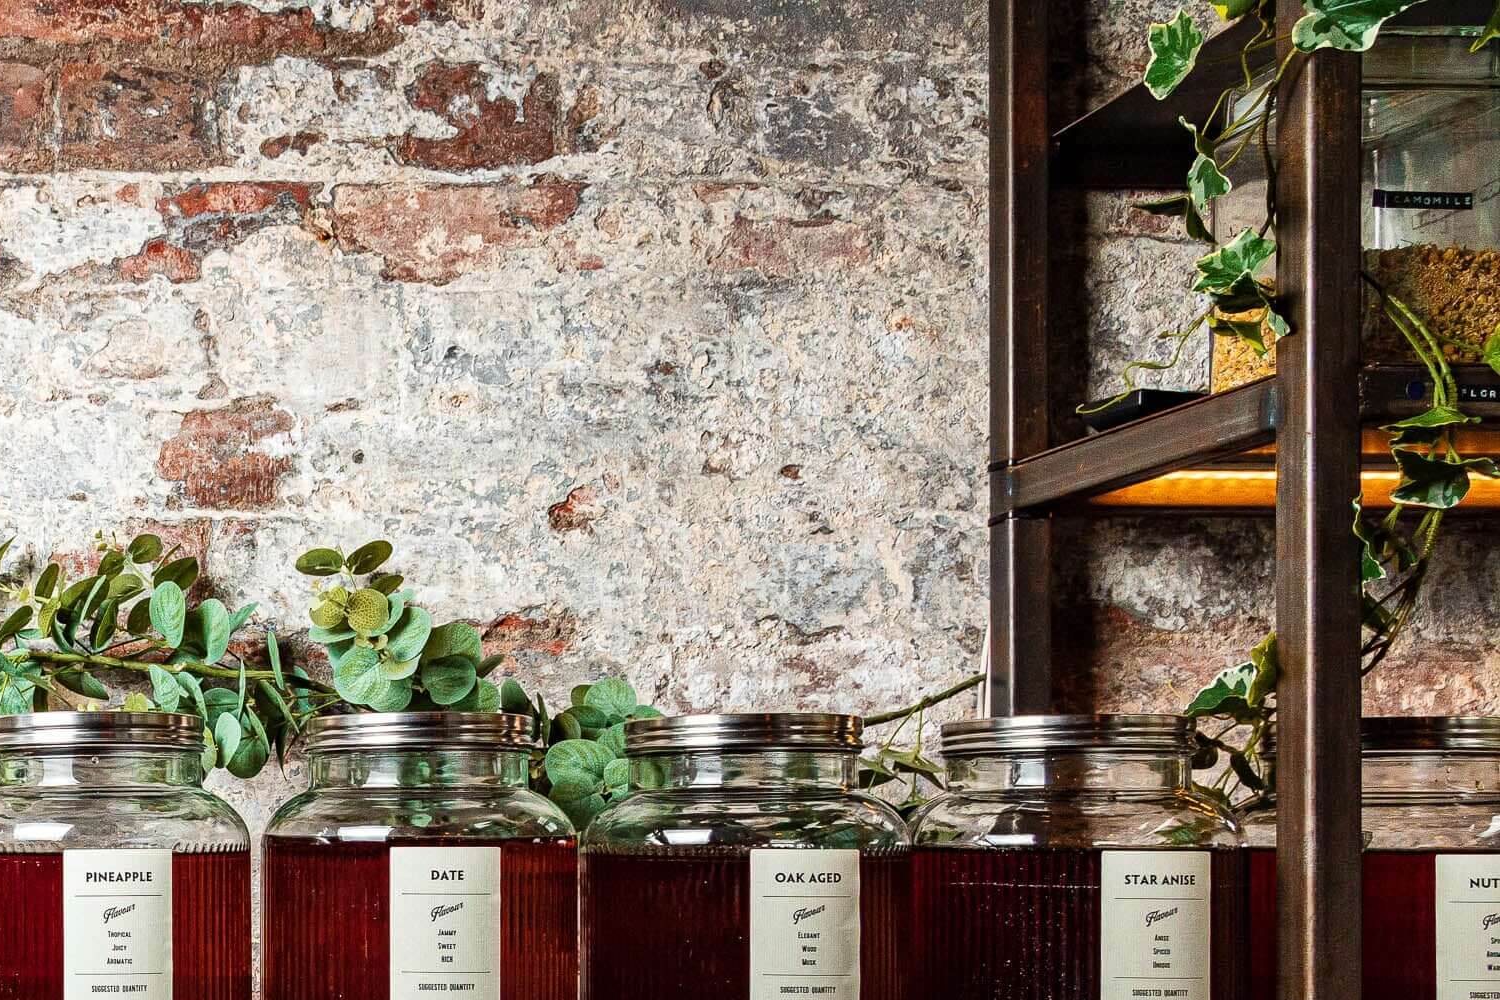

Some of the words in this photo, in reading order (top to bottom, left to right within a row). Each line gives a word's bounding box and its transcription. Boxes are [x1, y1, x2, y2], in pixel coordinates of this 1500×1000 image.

[1394, 196, 1472, 206] CAMOMILE
[86, 871, 153, 882] PINEAPPLE
[431, 870, 464, 881] DATE
[775, 873, 805, 883] OAK
[809, 873, 841, 883] AGED
[1125, 874, 1158, 885] STAR
[1162, 875, 1195, 885] ANISE
[1470, 878, 1500, 889] NUT
[103, 903, 135, 924] Flavour
[431, 902, 463, 922] Flavour
[793, 905, 825, 925] Flavour
[1146, 907, 1178, 927] Flavour
[91, 985, 120, 993] SUGGESTED
[419, 983, 447, 991] SUGGESTED
[450, 983, 475, 991] QUANTITY
[780, 986, 809, 994] SUGGESTED
[811, 986, 836, 994] QUANTITY
[1132, 989, 1161, 997] SUGGESTED
[1164, 989, 1188, 997] QUANTITY
